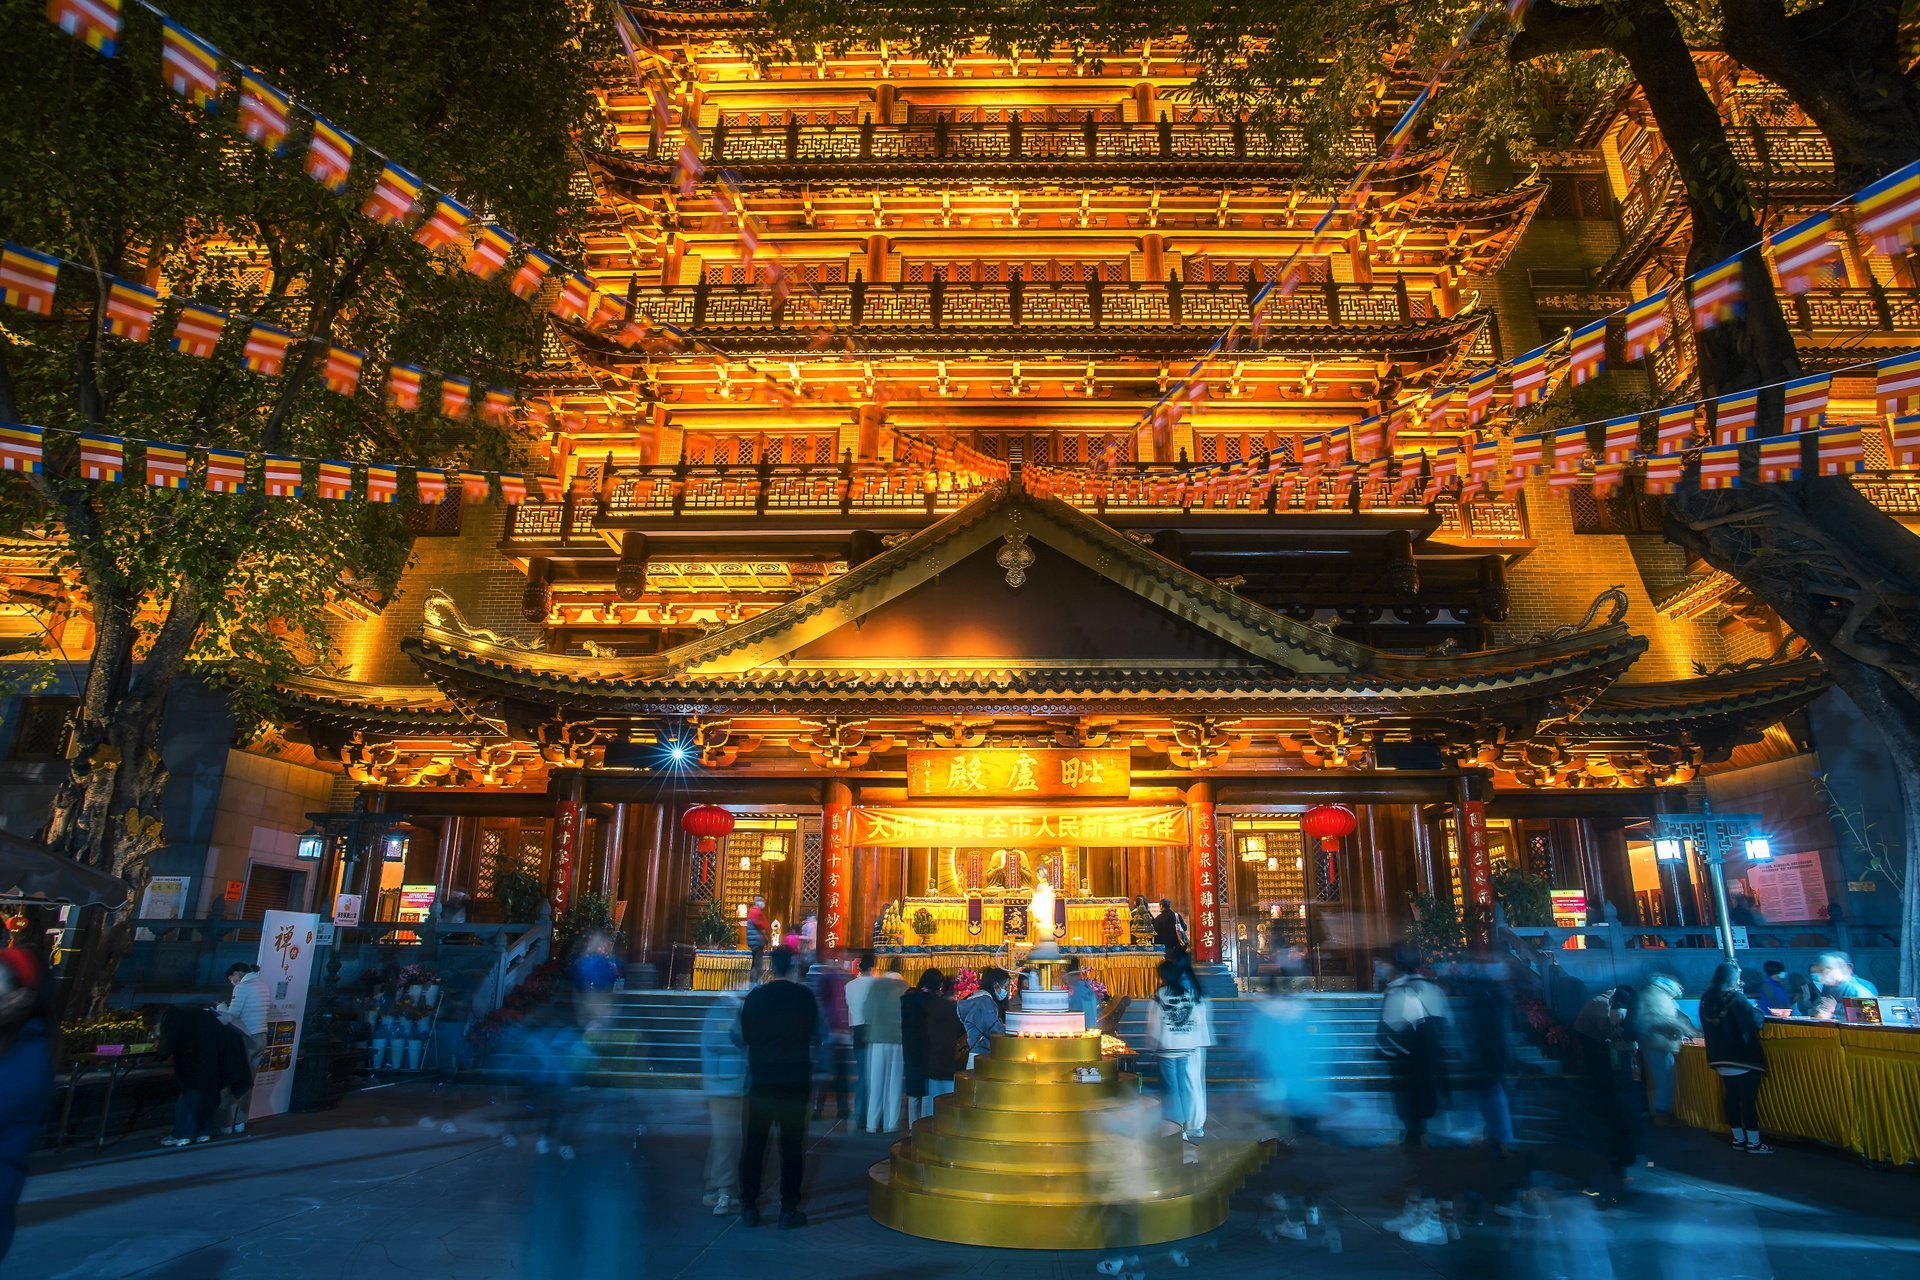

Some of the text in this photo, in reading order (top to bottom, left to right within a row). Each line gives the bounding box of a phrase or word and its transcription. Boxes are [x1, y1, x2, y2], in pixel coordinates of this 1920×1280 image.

[867, 815, 1175, 839] 大佛寺恭賀全市人民新春吉祥
